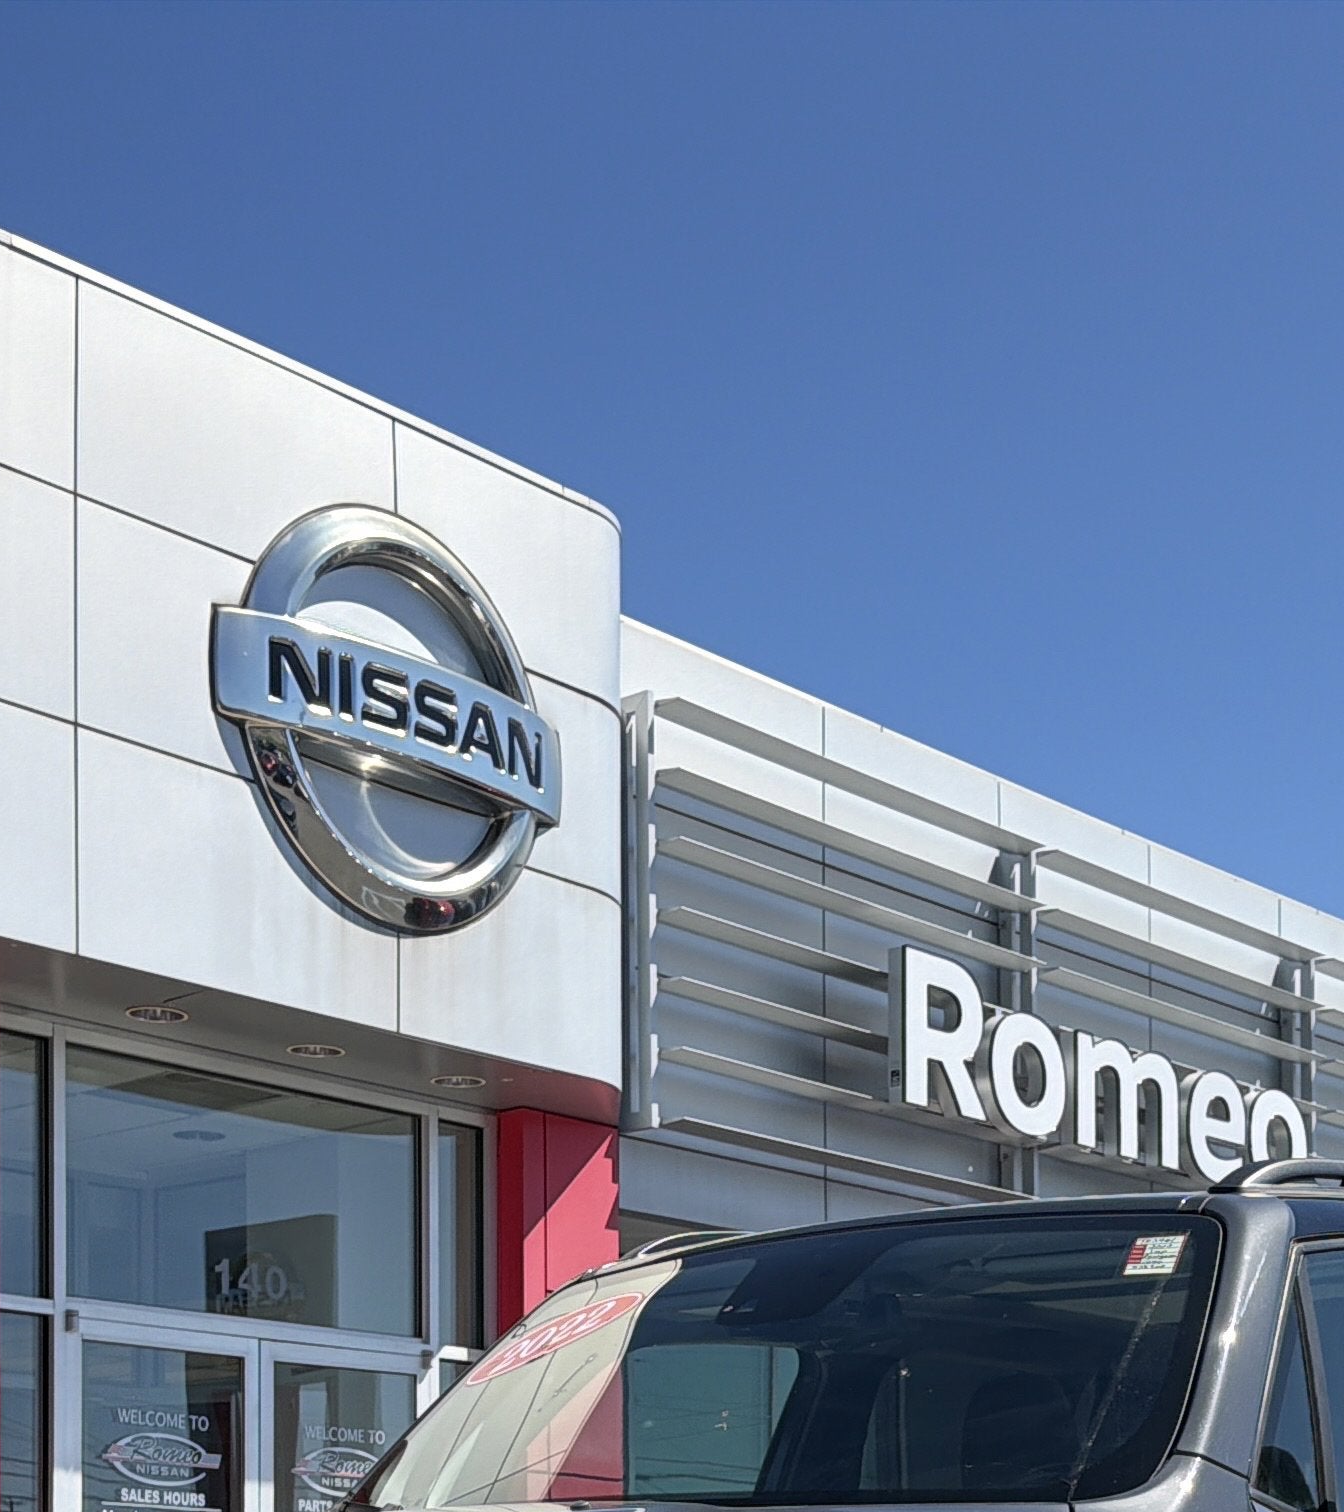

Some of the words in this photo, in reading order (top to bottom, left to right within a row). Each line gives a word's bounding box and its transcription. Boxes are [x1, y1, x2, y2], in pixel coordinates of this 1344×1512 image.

[267, 636, 545, 794] NISSAN
[899, 944, 1309, 1184] Romeo
[214, 1258, 288, 1301] 140
[487, 1300, 618, 1376] 2022
[117, 1408, 187, 1429] WELCOME
[189, 1415, 210, 1432] TO
[305, 1425, 366, 1444] WELCOME
[367, 1430, 386, 1445] TO
[127, 1436, 203, 1465] Romeo
[315, 1449, 373, 1475] Rome
[135, 1463, 191, 1478] NISSAN
[120, 1487, 160, 1504] SALES
[163, 1490, 206, 1507] HOURS
